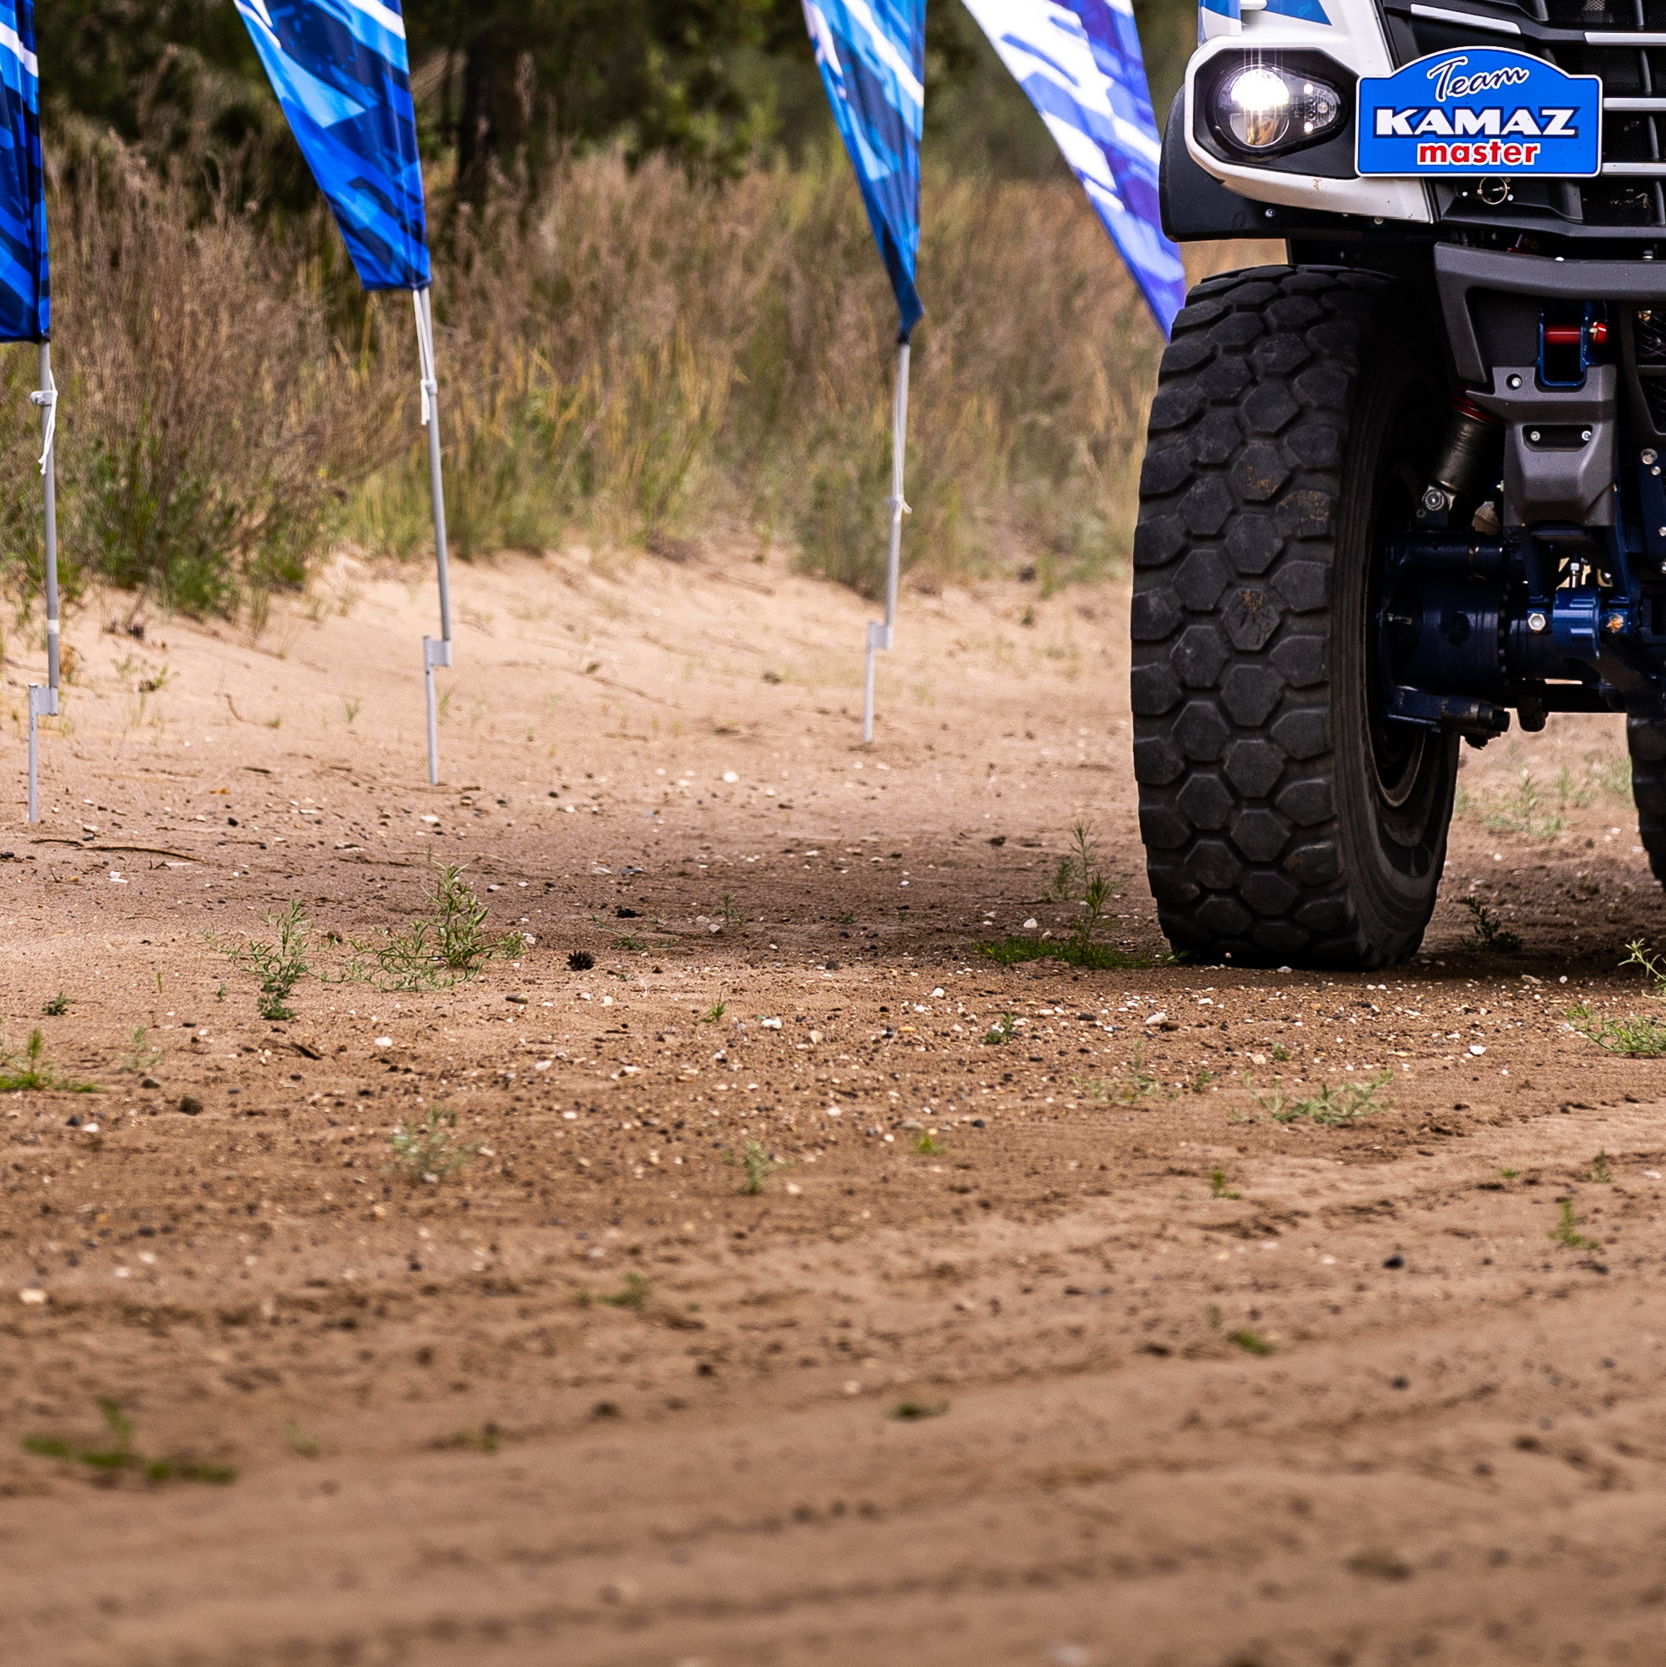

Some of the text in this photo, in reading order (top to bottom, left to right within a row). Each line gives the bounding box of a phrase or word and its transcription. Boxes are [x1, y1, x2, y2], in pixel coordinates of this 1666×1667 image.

[1426, 56, 1530, 102] Team
[1375, 106, 1580, 138] KAMAZ
[1417, 140, 1541, 165] master
